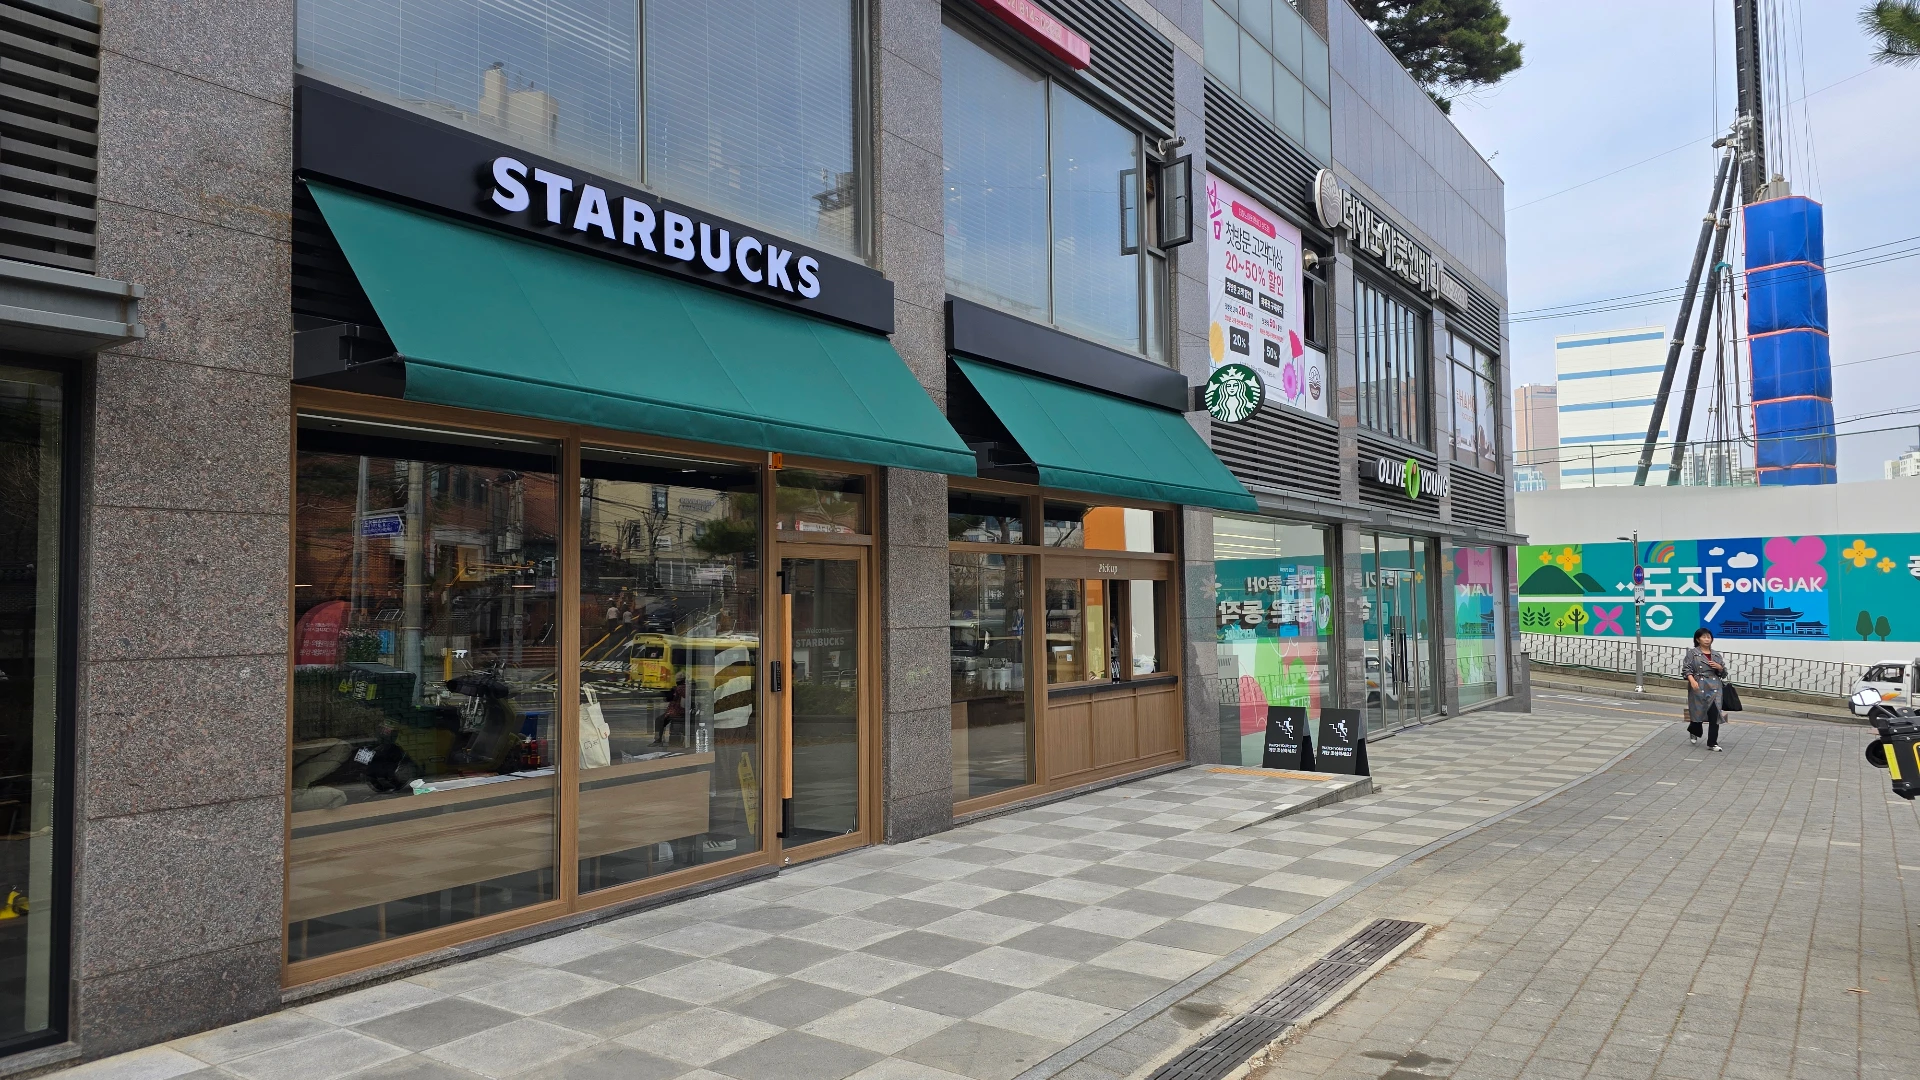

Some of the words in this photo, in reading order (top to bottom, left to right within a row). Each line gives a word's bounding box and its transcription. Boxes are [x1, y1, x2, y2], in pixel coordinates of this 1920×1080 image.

[491, 155, 821, 299] STARBUCKS
[1225, 220, 1252, 255] 첫방문
[1339, 188, 1440, 300] 더하노이풋앤바디
[1225, 250, 1266, 286] 20~50%
[1267, 269, 1284, 297] 할인
[1232, 333, 1246, 349] 20%
[1266, 345, 1278, 361] 50%
[1378, 458, 1406, 488] OLIVE
[1420, 470, 1449, 498] YOUNG
[1721, 576, 1824, 594] DONGJAK
[795, 636, 845, 648] STARBUCKS
